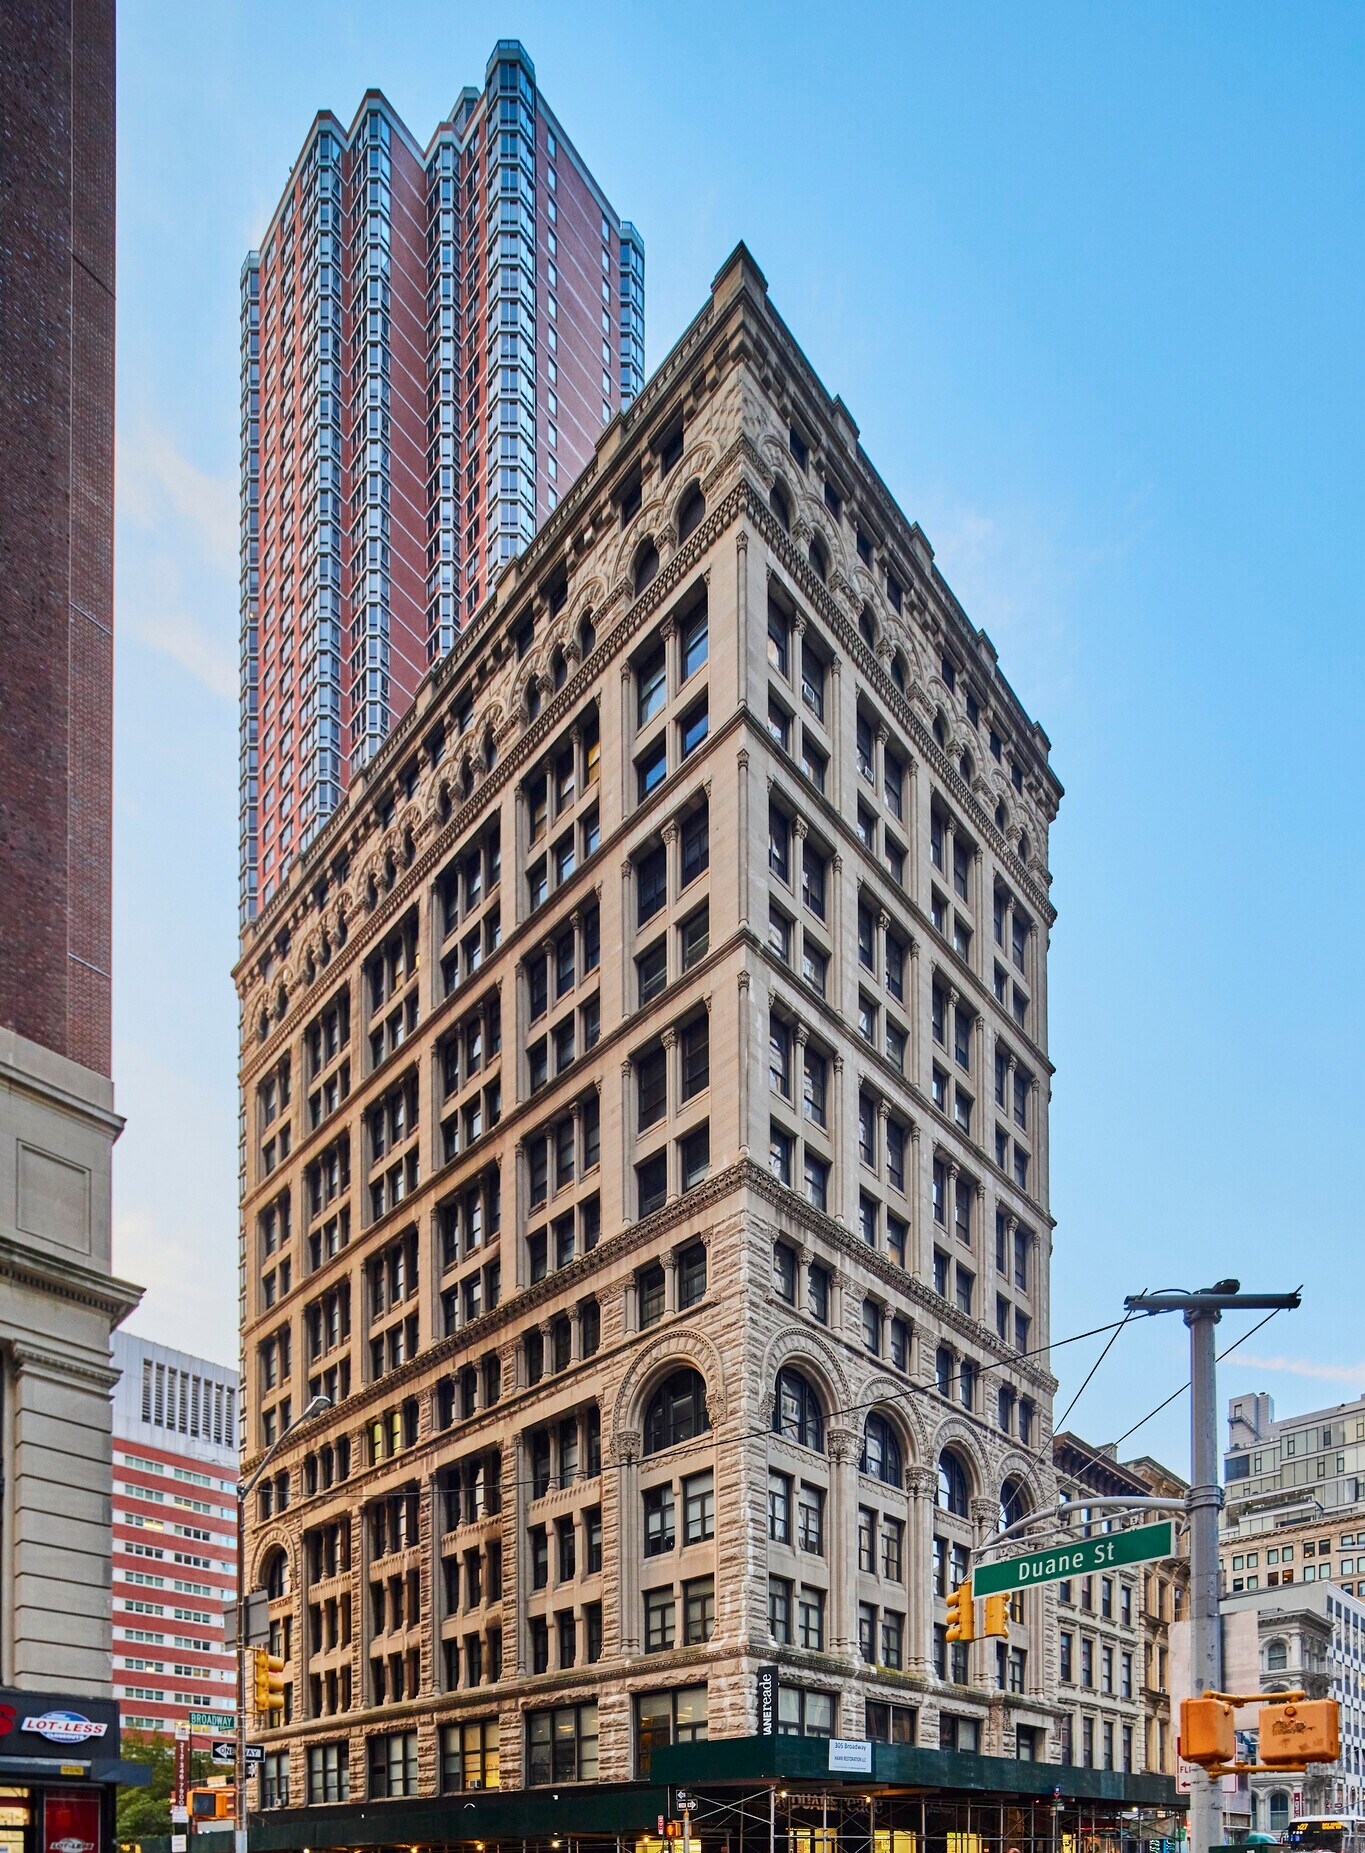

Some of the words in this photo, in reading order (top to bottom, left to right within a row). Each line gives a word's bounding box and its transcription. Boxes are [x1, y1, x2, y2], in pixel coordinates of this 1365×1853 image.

[1018, 1552, 1083, 1581] Duane
[1094, 1541, 1114, 1565] St
[191, 1713, 232, 1726] BROADWAY
[27, 1720, 103, 1734] LOT-LESS
[844, 1743, 866, 1751] Broadway
